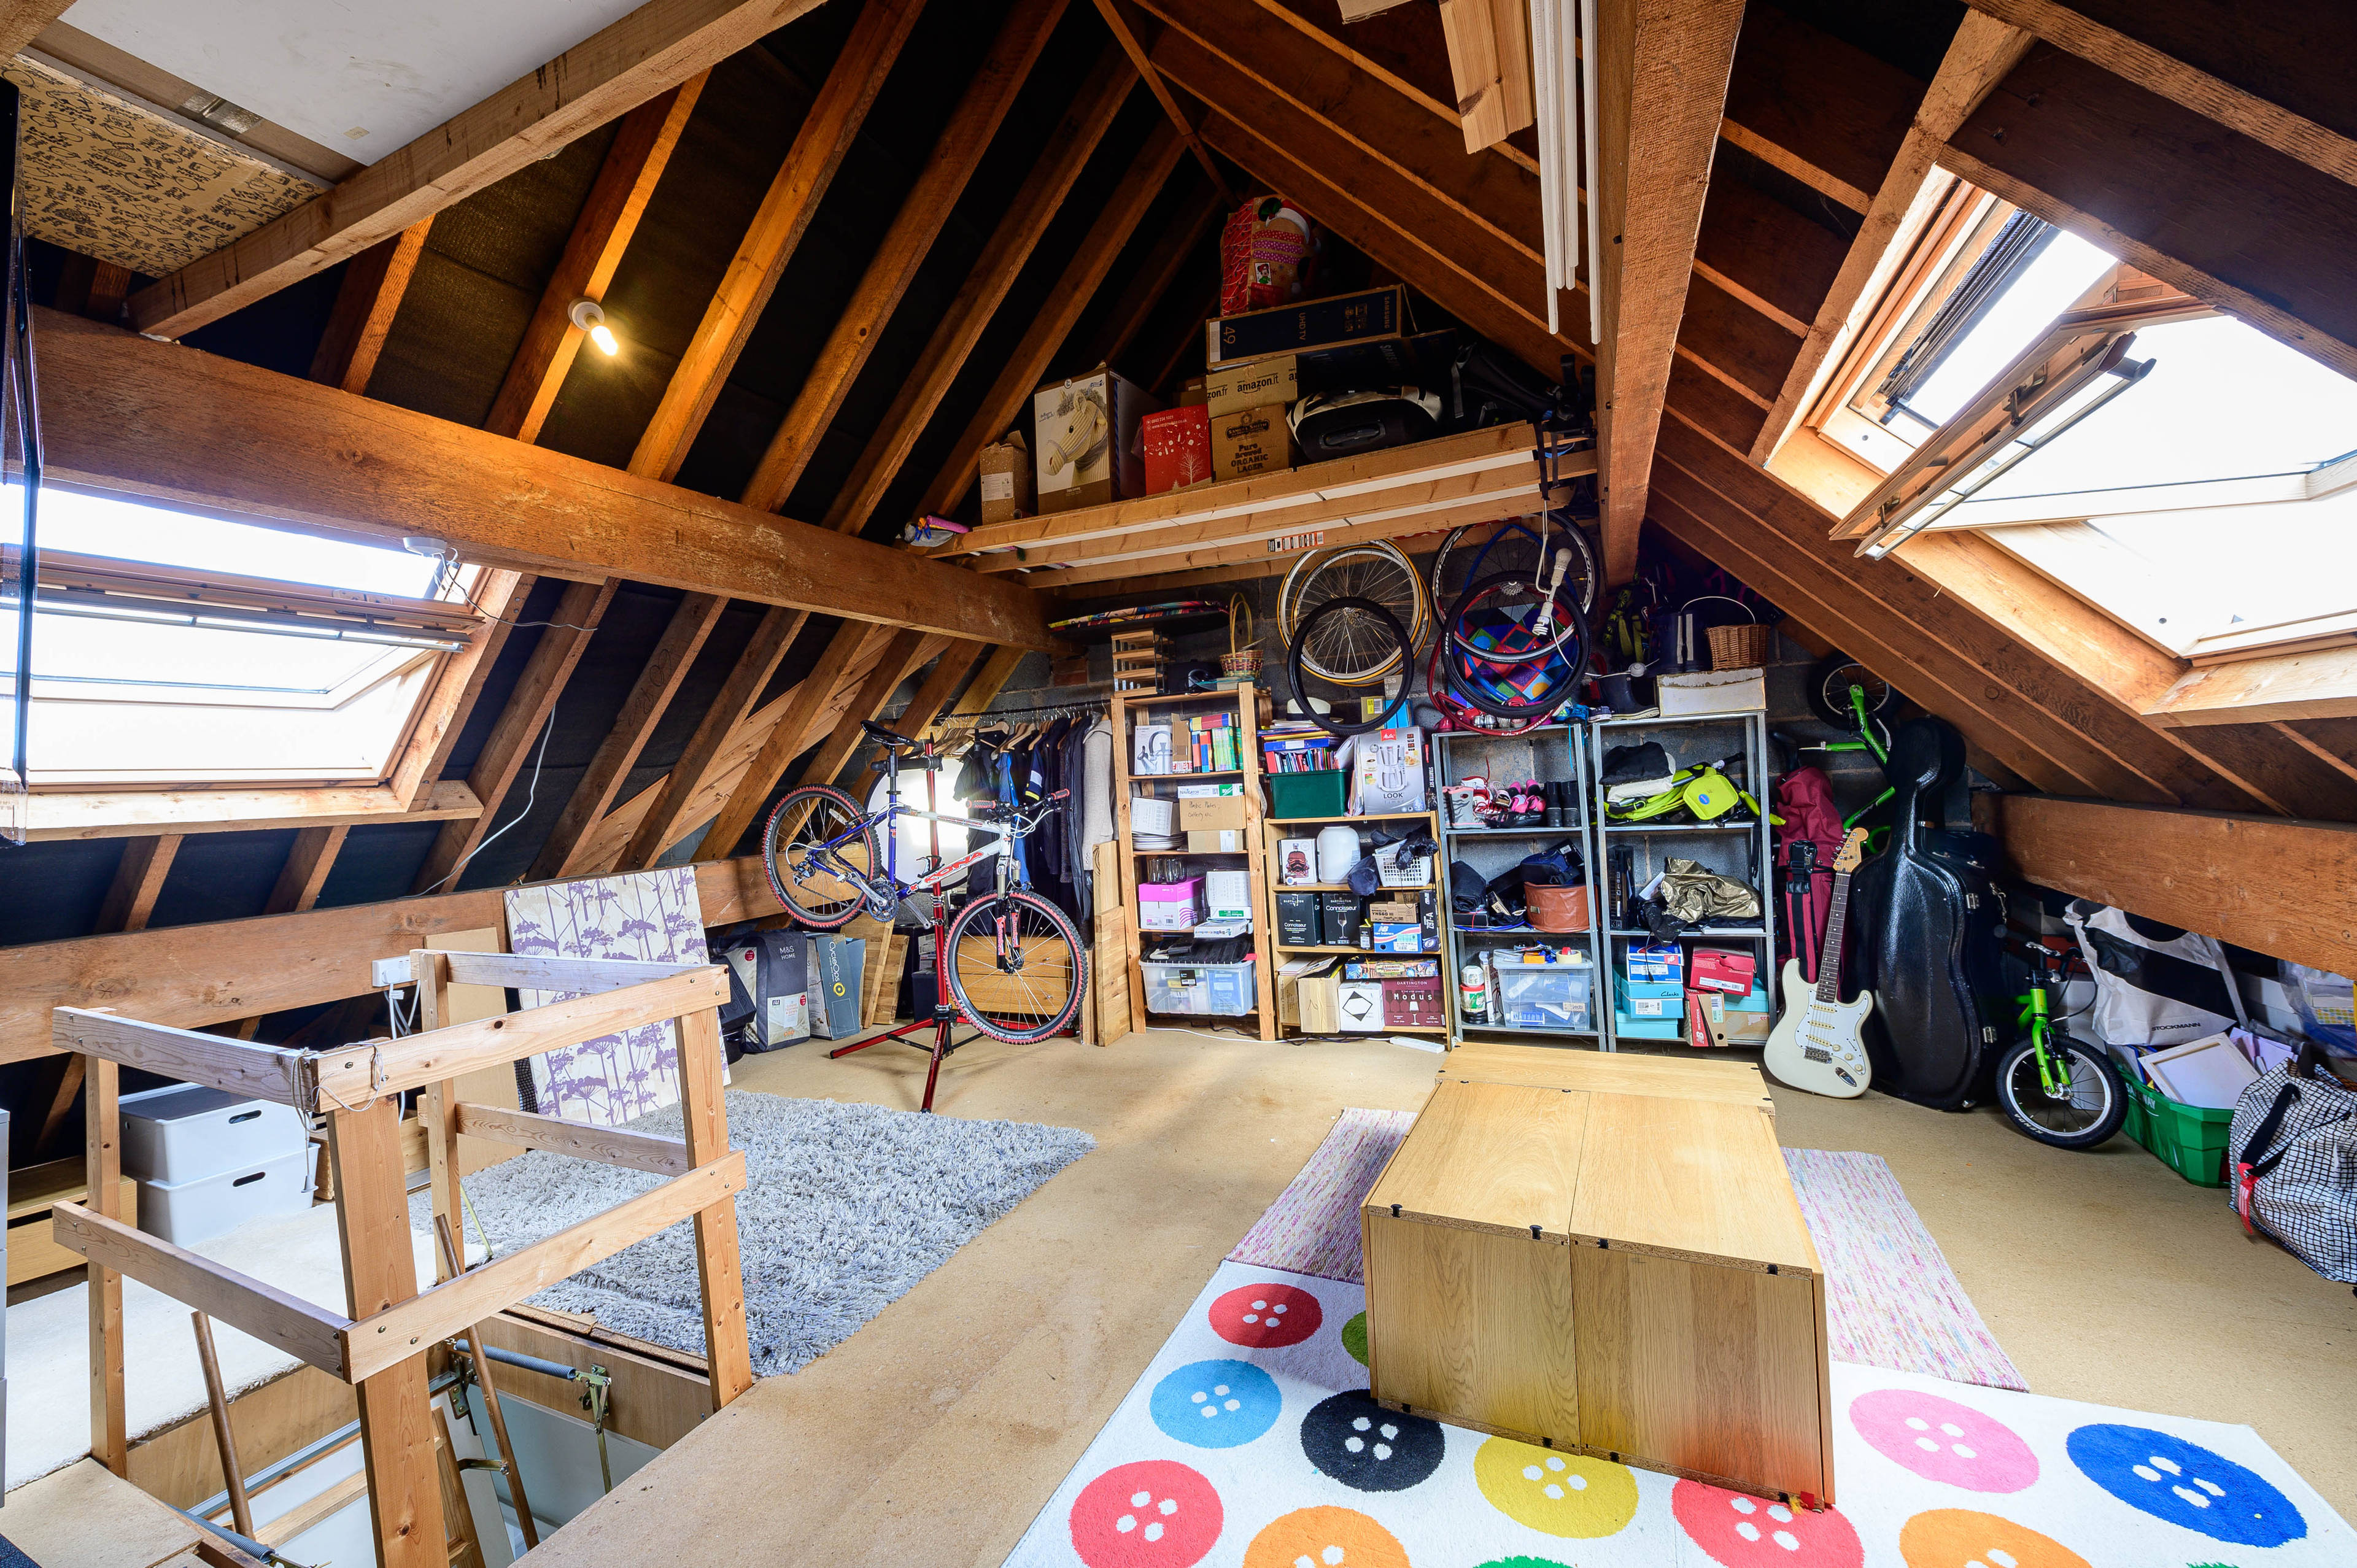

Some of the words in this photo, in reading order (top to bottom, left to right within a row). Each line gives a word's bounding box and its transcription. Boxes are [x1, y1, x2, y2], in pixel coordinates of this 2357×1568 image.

[1223, 326, 1236, 344] 49
[1298, 330, 1306, 341] TV
[1237, 374, 1280, 393] amazon.it
[1239, 442, 1258, 452] Pure
[1231, 454, 1269, 467] ORGANIC
[1237, 462, 1264, 473] LAGER
[924, 851, 983, 884] KONA
[1426, 912, 1434, 929] Z97-A
[780, 946, 795, 954] M&S
[829, 941, 841, 982] CycleOps
[2151, 1022, 2201, 1032] STOCKMANN
[2014, 1113, 2045, 1135] KENDA
